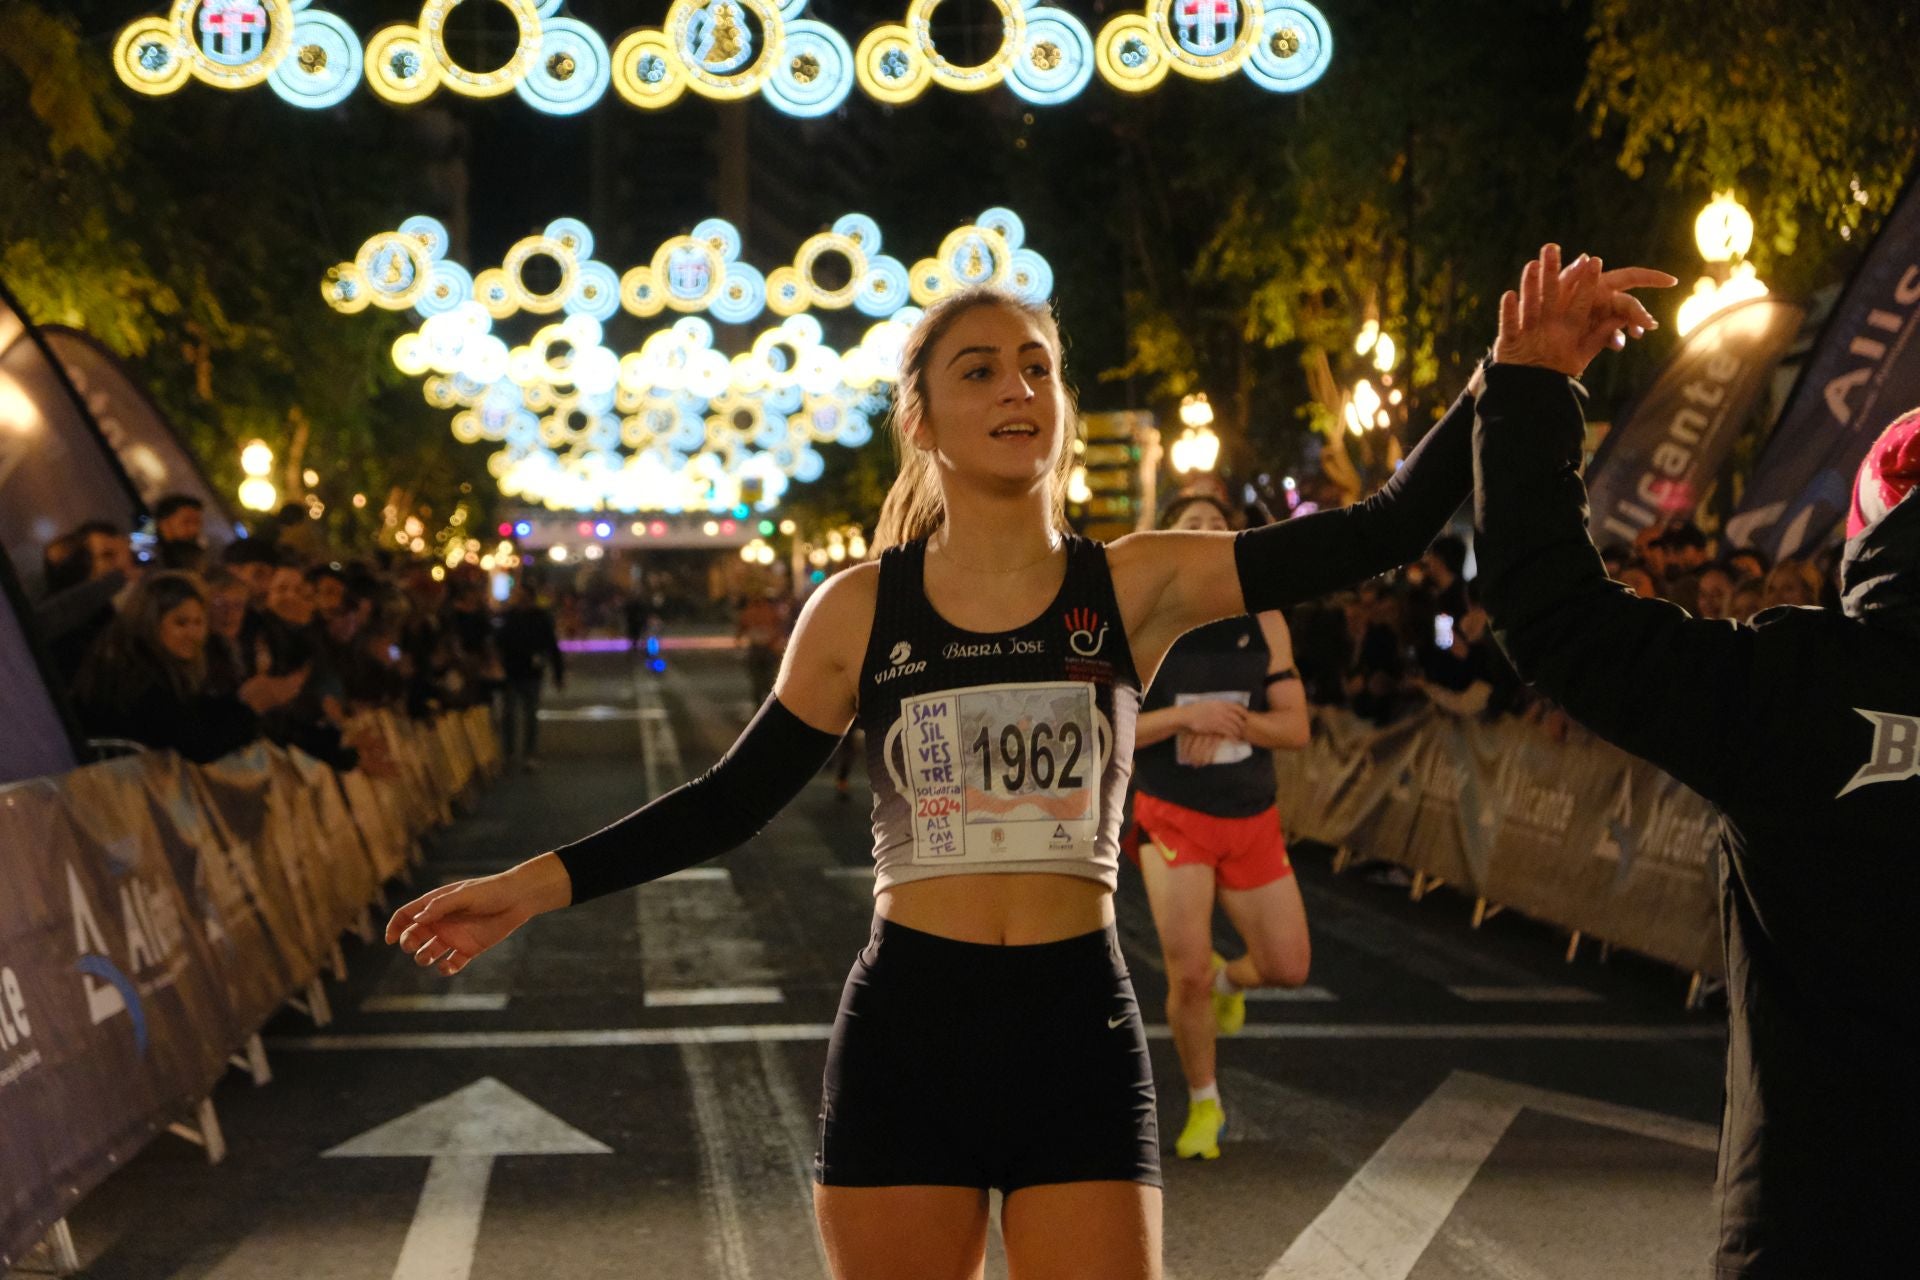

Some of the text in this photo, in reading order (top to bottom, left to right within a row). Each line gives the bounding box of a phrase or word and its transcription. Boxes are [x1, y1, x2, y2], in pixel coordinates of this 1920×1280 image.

[1604, 350, 1742, 543] licante
[942, 636, 1047, 660] BARRA JOSE
[874, 660, 927, 685] VIATOR
[912, 702, 947, 726] SAN
[918, 741, 951, 763] VES
[972, 722, 1083, 791] 1962
[1835, 707, 1920, 799] B
[920, 764, 954, 783] TRE
[917, 796, 961, 817] 2024
[930, 841, 956, 855] TE
